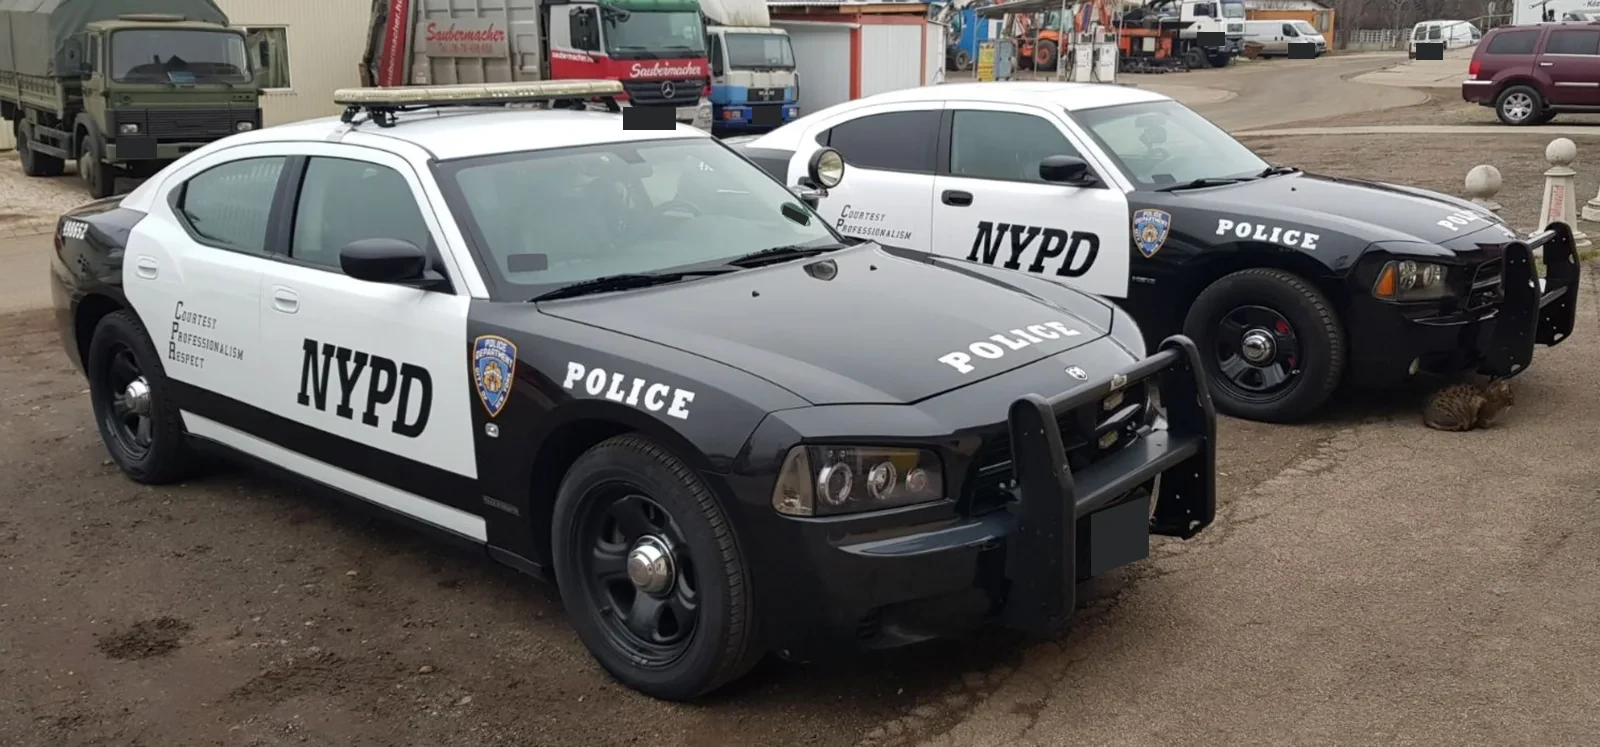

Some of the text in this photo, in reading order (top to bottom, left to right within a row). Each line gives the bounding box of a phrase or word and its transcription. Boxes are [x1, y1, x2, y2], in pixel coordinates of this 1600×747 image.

[426, 22, 504, 41] Saubermacher
[629, 61, 701, 78] Saubermacher
[835, 218, 912, 240] PROFESSIONALISM
[1436, 210, 1479, 231] POL
[1215, 219, 1320, 250] POLICE
[966, 220, 1101, 278] NYPD
[171, 321, 244, 360] PROFESSIONALISM
[485, 339, 508, 352] POLICE
[937, 321, 1081, 374] POLICE
[168, 341, 205, 368] RESPECT
[475, 347, 513, 367] DEPARTMENT
[297, 338, 433, 438] NYPD
[562, 361, 695, 420] POLICE
